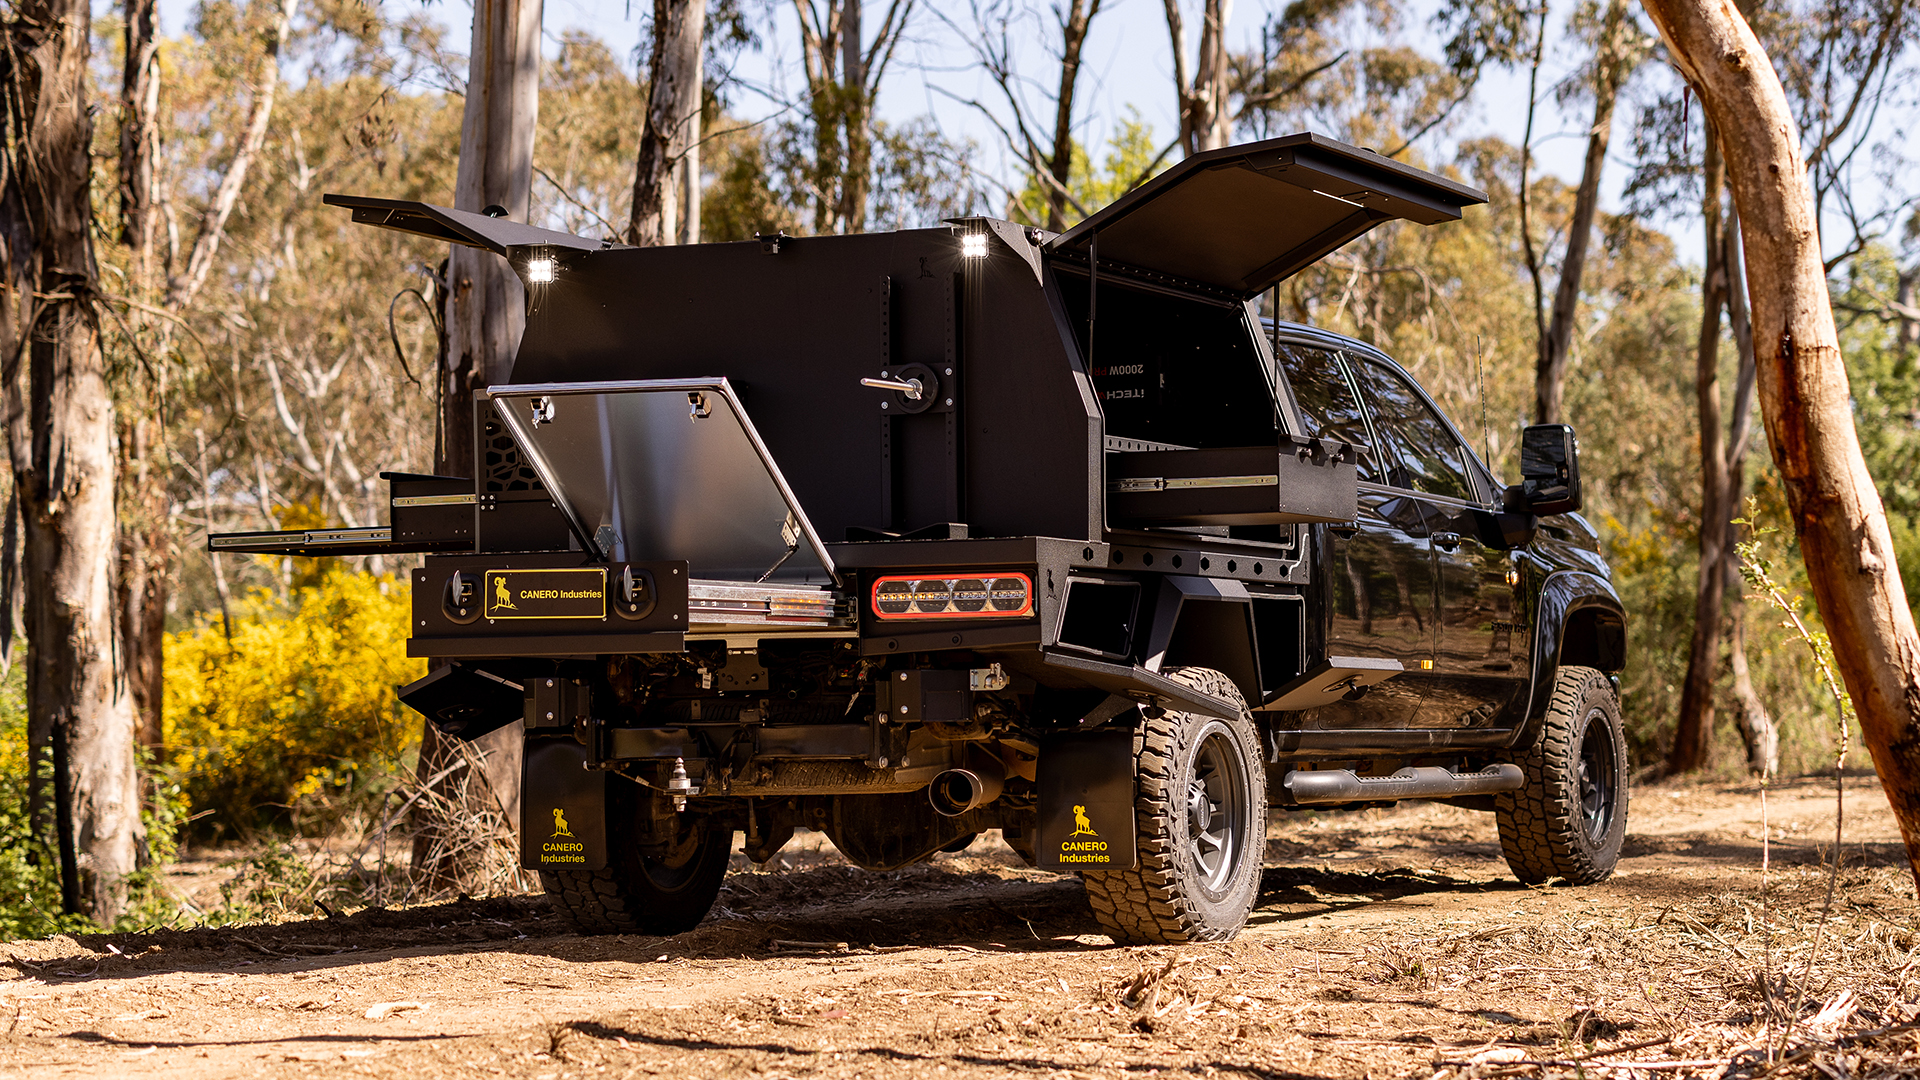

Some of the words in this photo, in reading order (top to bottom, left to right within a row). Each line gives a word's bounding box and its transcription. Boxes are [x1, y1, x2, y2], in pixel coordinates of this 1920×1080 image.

[1091, 366, 1107, 376] PR
[1109, 364, 1144, 376] 2000W
[520, 589, 559, 599] CANERO
[560, 589, 602, 599] Industries
[542, 842, 584, 852] CANERO
[1061, 841, 1108, 852] CANERO
[540, 853, 586, 863] Industries
[1059, 853, 1110, 863] Industries
